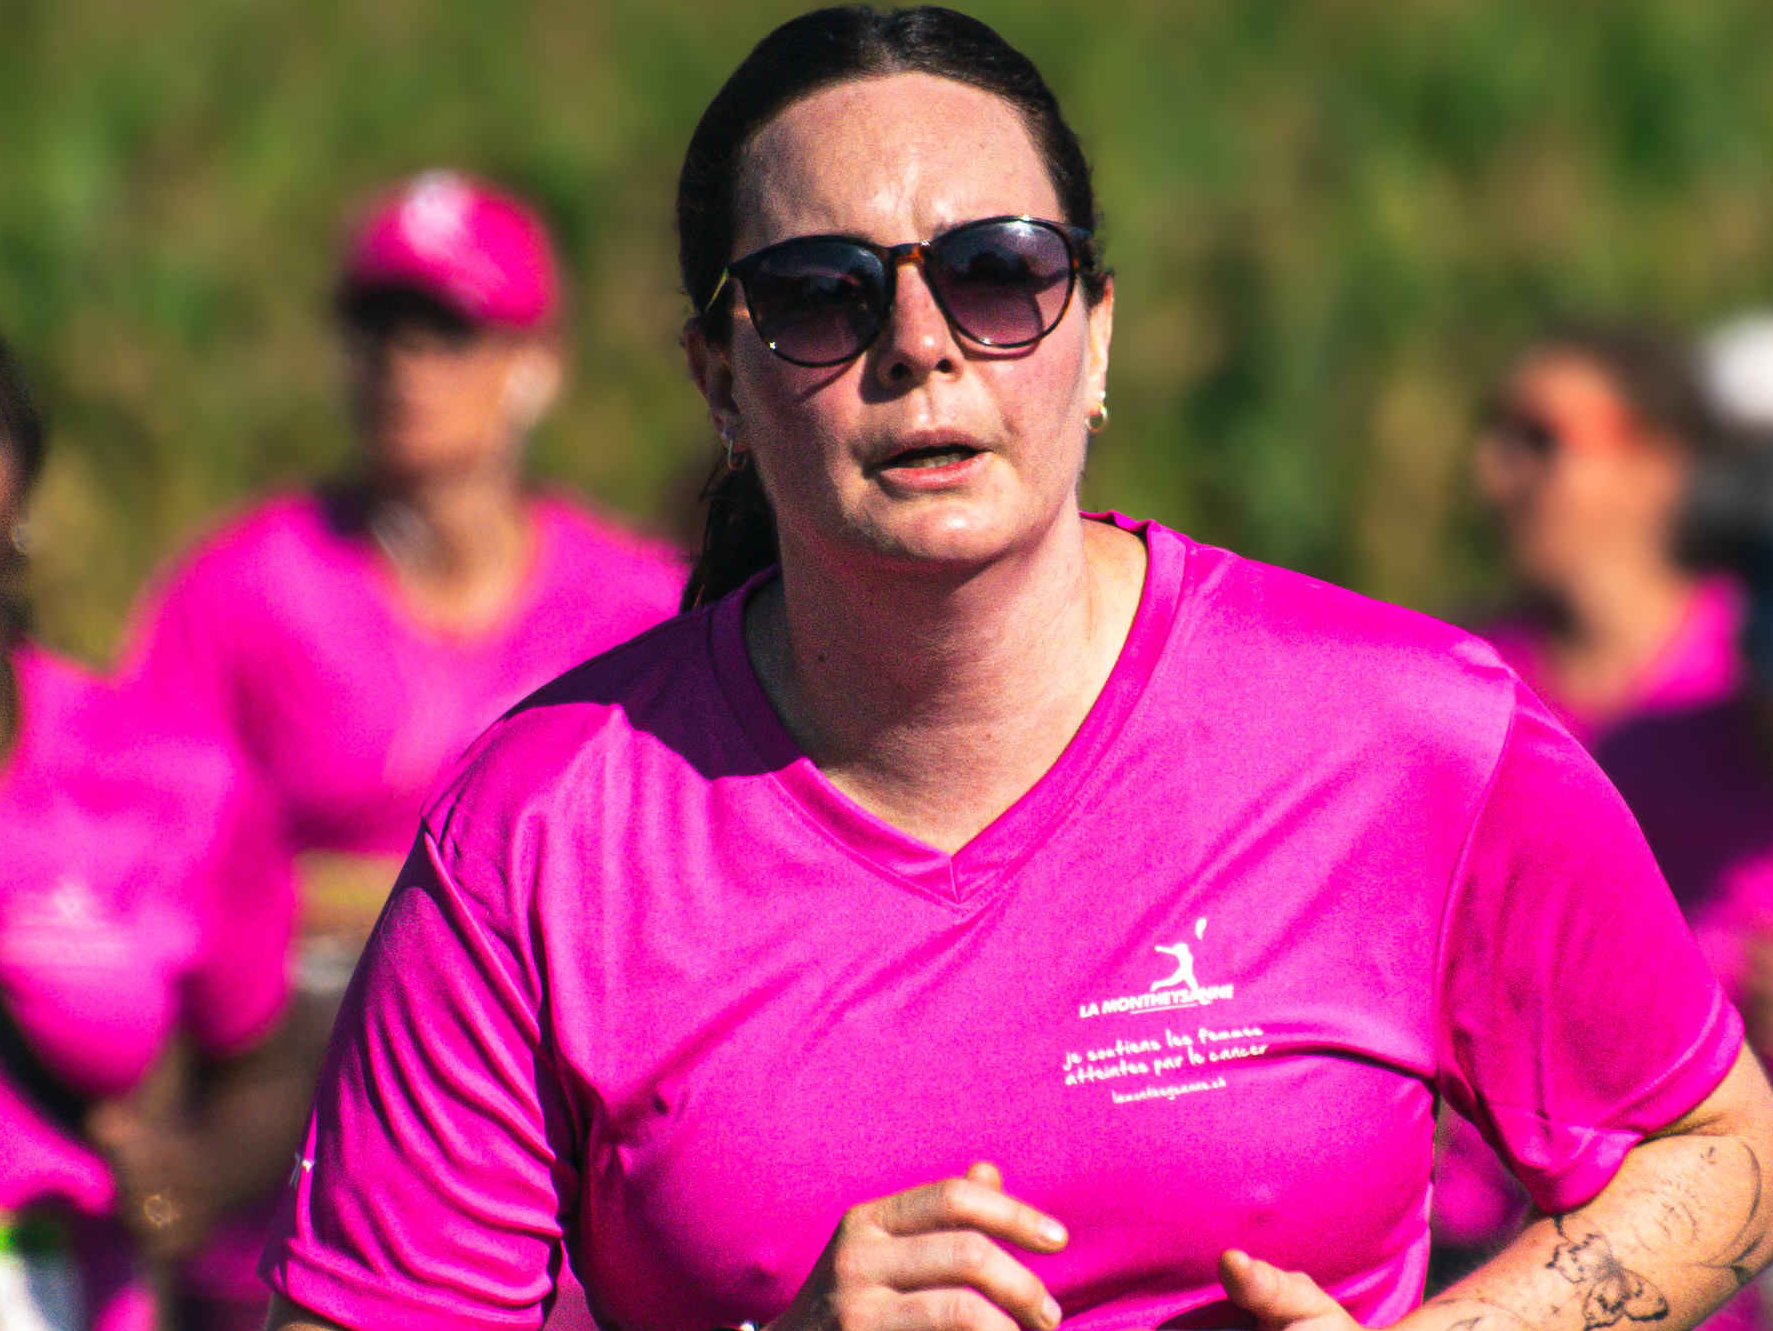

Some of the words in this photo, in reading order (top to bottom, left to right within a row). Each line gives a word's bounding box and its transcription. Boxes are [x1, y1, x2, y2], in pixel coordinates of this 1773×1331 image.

[1079, 1003, 1099, 1018] LA
[1102, 983, 1234, 1014] MONTHEYSANNE
[1062, 1051, 1083, 1072] je
[1153, 1055, 1184, 1077] par
[1209, 1044, 1268, 1063] cancer
